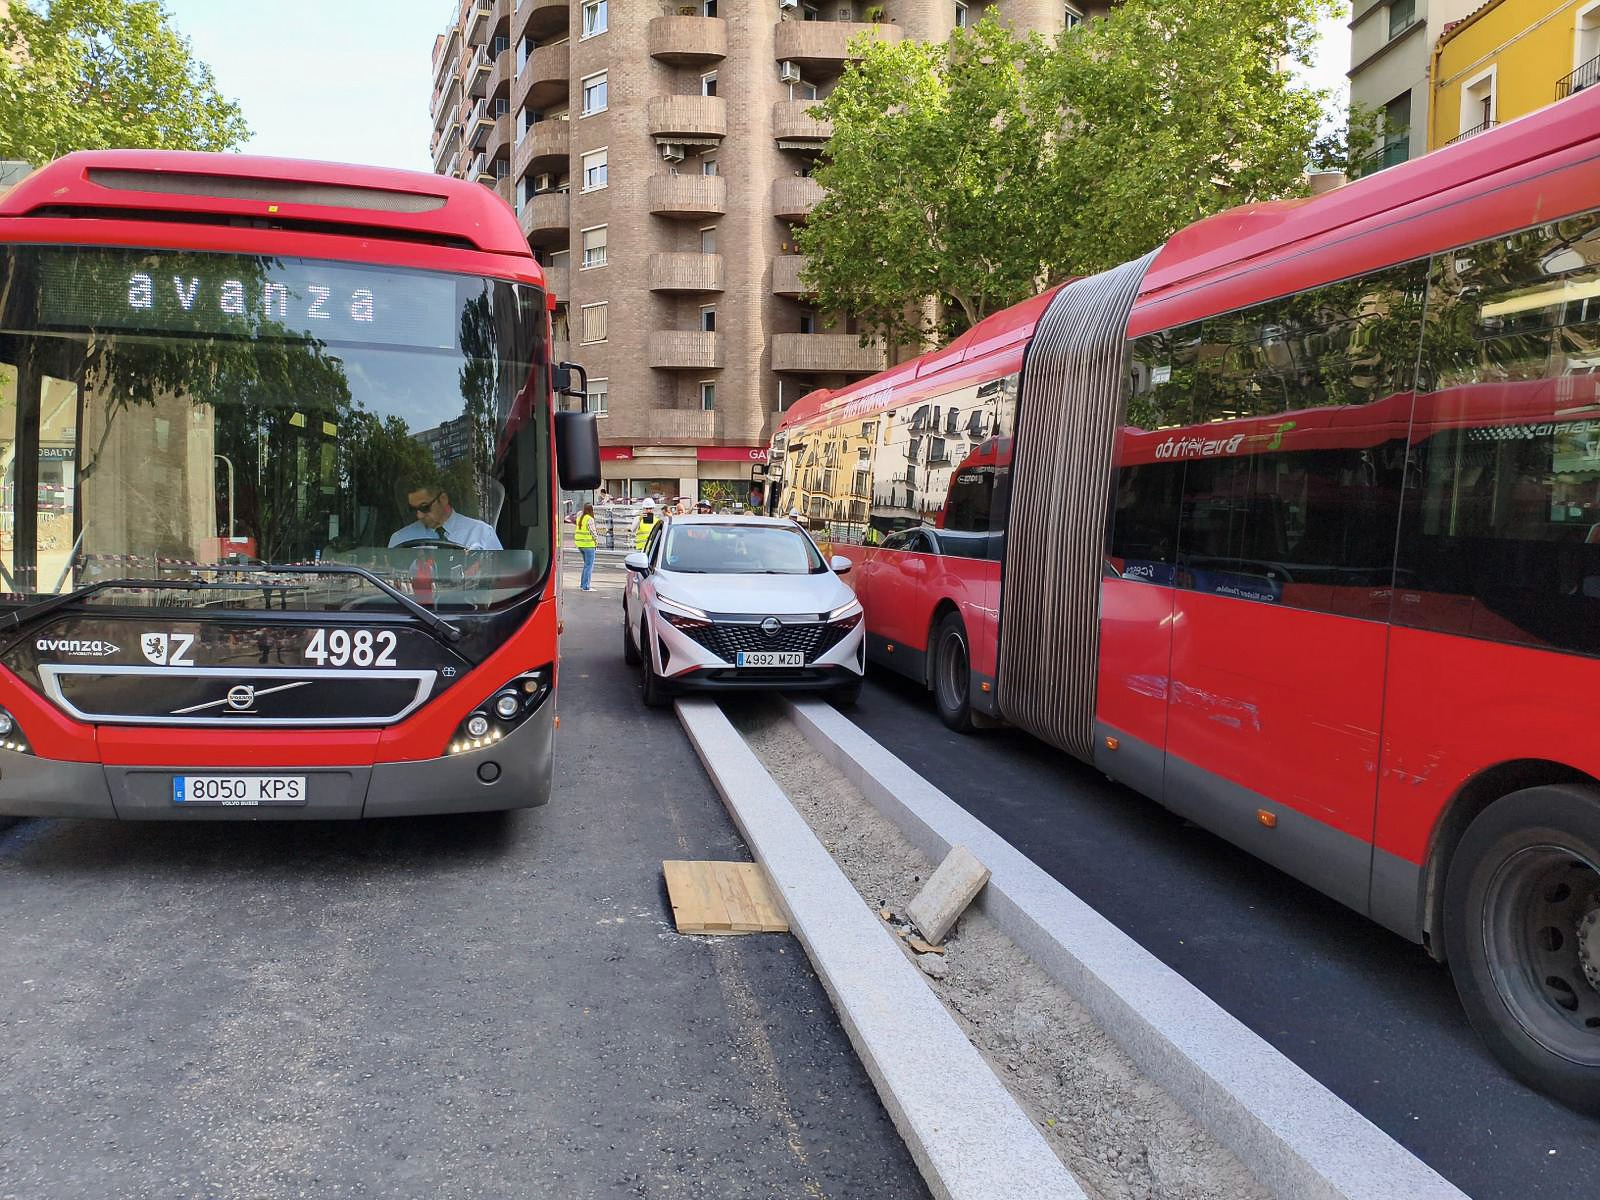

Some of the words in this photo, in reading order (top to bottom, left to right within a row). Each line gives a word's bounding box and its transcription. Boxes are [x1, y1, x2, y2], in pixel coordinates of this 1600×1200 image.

[128, 272, 374, 322] avanza
[749, 449, 769, 460] GA
[36, 639, 103, 652] avanza
[169, 633, 195, 667] Z
[304, 629, 397, 667] 4982
[745, 654, 775, 666] 4992
[778, 654, 801, 665] MZD
[192, 779, 247, 799] 8050
[259, 779, 300, 799] KPS
